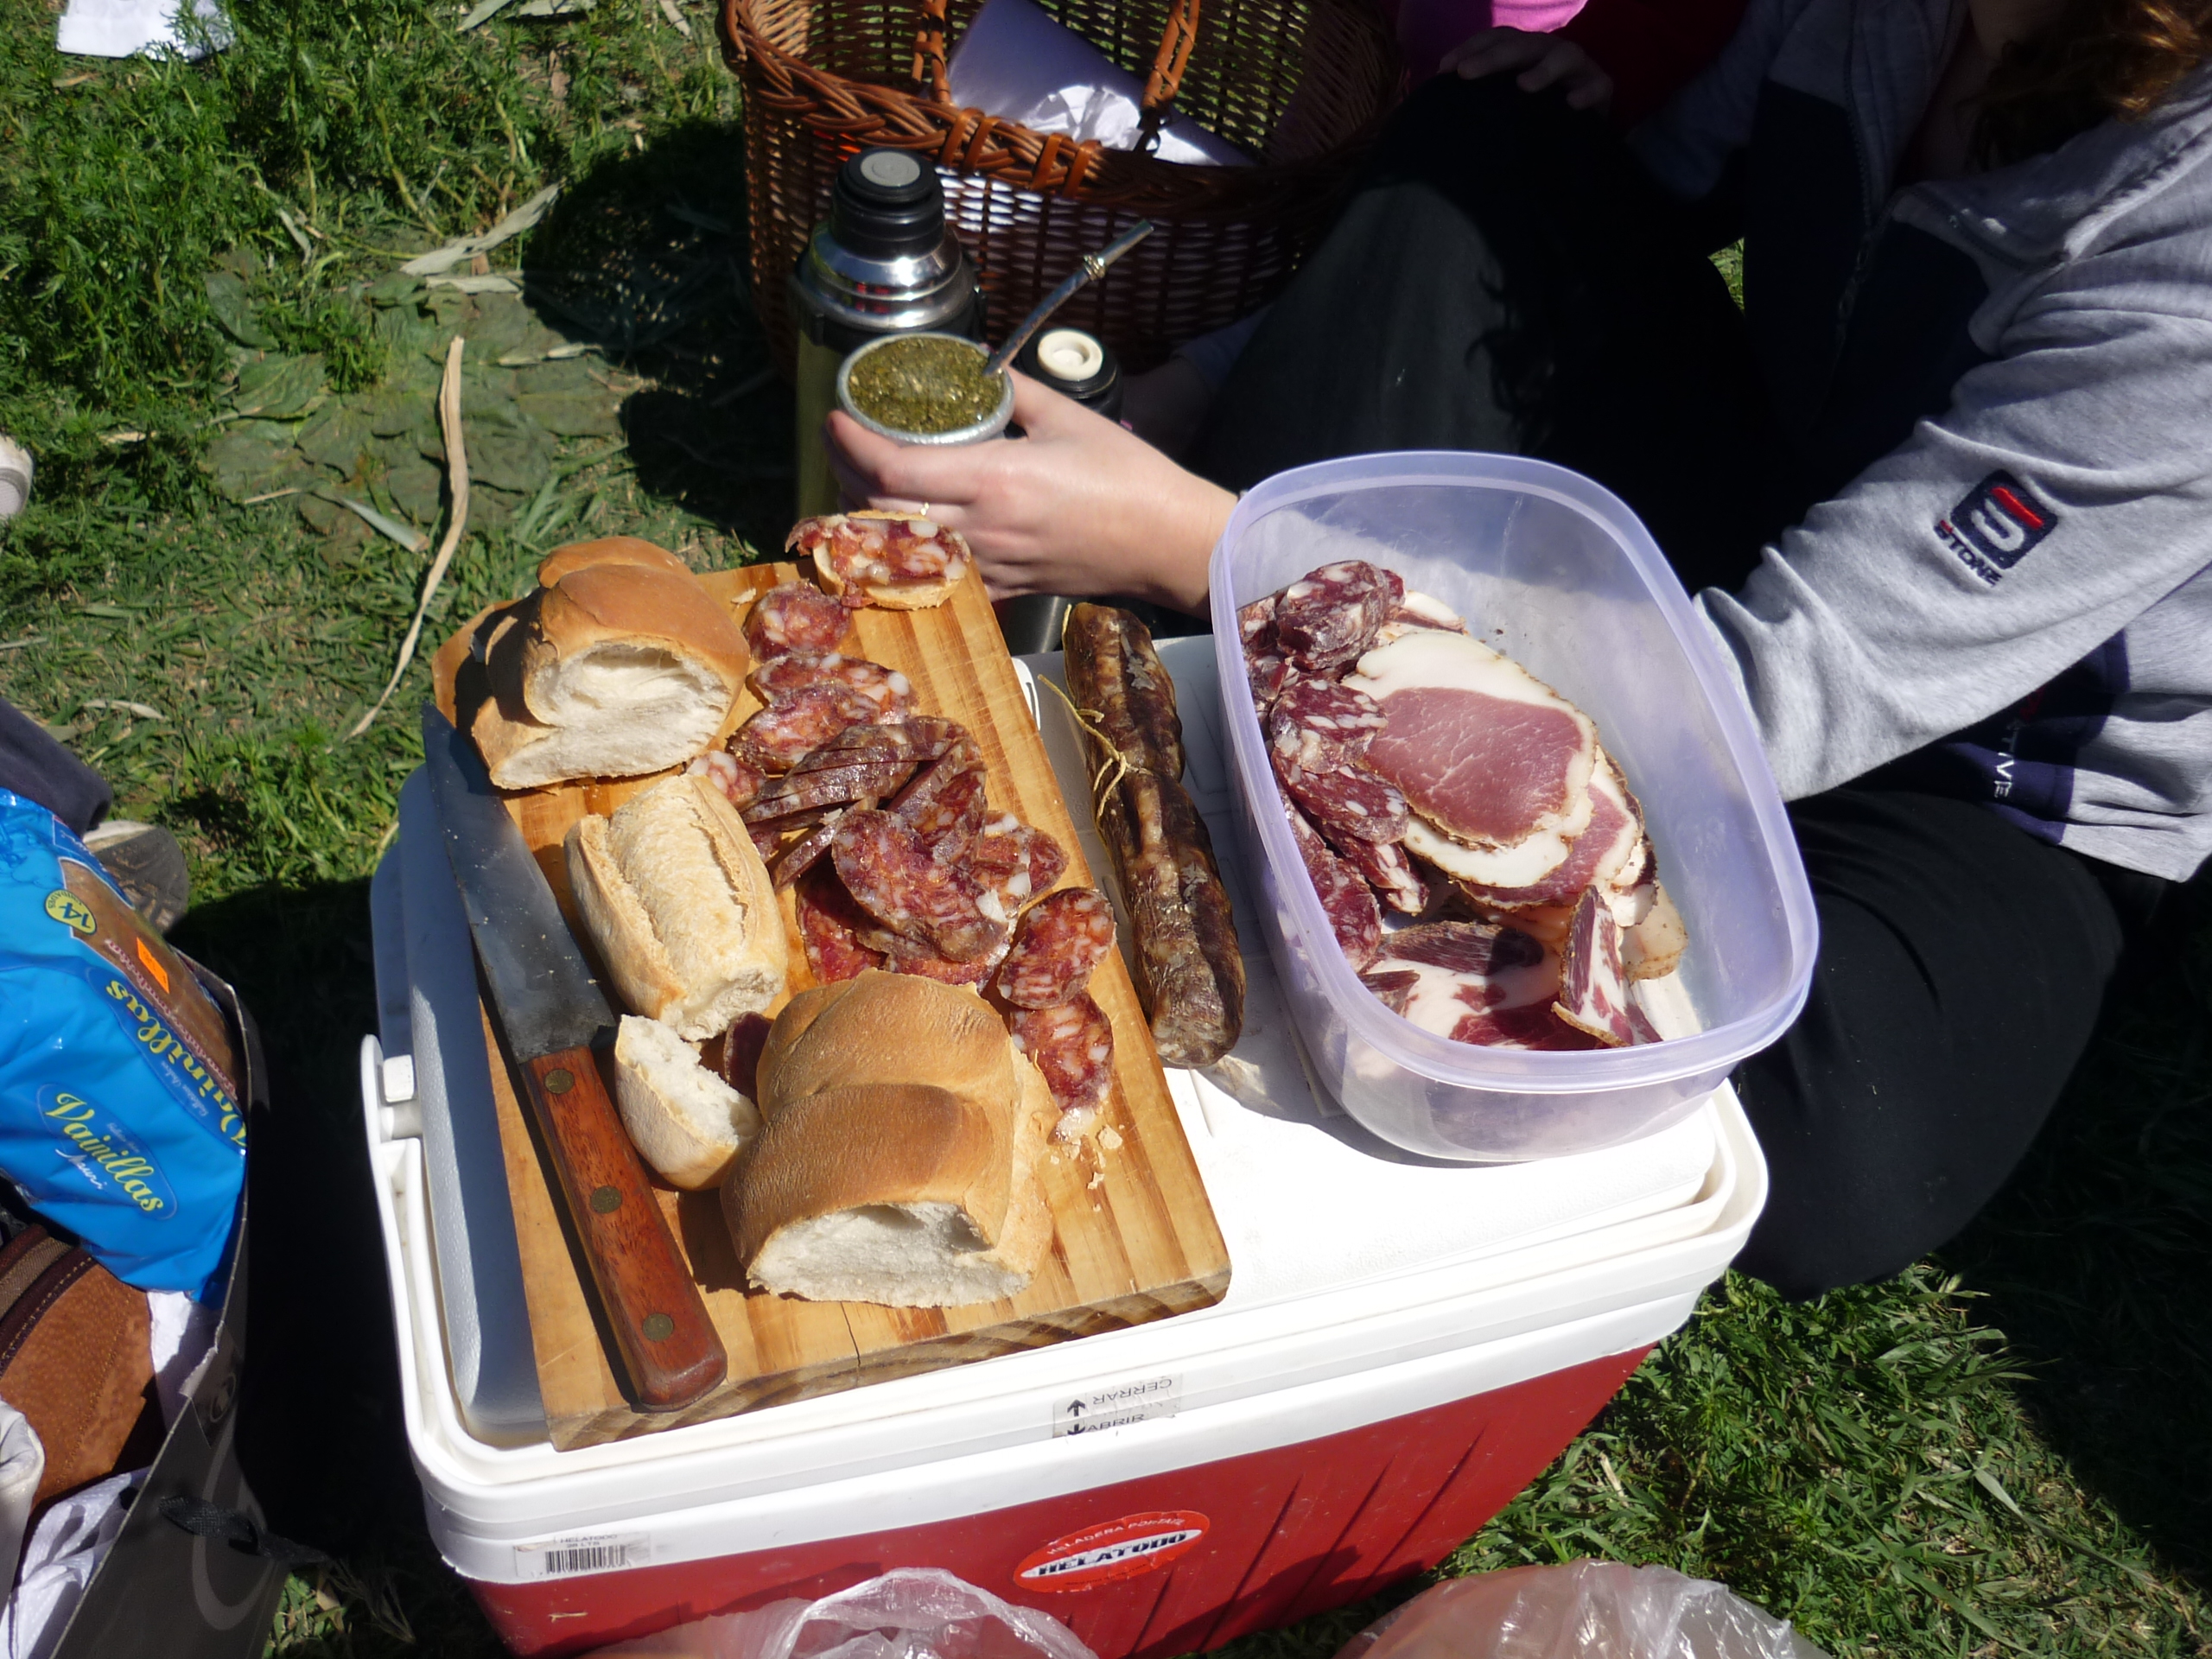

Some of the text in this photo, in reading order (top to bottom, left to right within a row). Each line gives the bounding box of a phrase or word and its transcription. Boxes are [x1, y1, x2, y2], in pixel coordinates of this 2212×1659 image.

[1933, 519, 2003, 586] STONE
[59, 902, 91, 929] 14
[105, 979, 247, 1147] Vainillas
[44, 1092, 164, 1211] Vainillas
[1092, 1378, 1173, 1405] CERRAR
[1087, 1414, 1145, 1433] ABRIR
